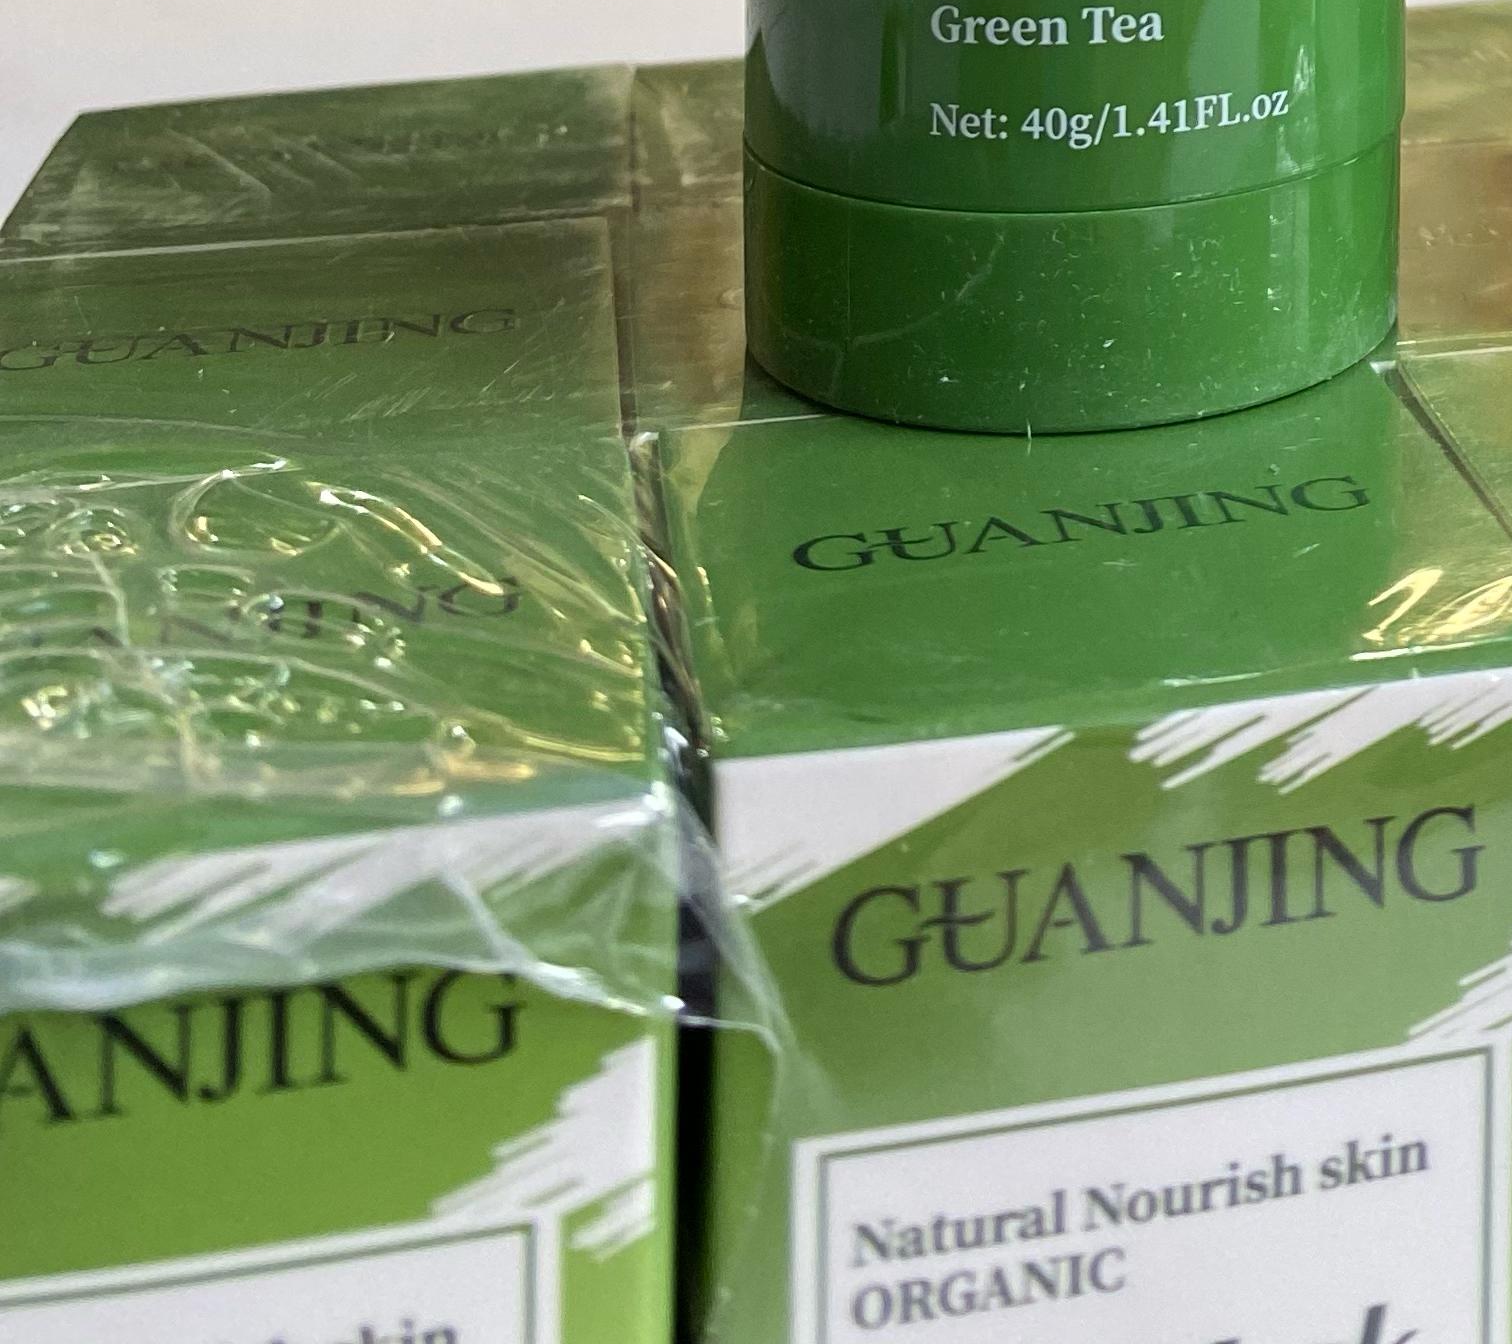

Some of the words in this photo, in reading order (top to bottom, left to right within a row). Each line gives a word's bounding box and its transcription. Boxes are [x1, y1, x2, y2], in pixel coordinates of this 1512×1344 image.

[932, 6, 1068, 45] Green
[1082, 7, 1164, 43] Tea
[930, 103, 1008, 139] Net:
[1021, 89, 1289, 150] 40g/1.41FL.oz
[793, 475, 1369, 572] GUANJING
[831, 805, 1486, 989] GUANJING
[850, 1191, 1067, 1270] Natural
[1083, 1152, 1303, 1228] Nourish
[1318, 1132, 1430, 1190] skin
[850, 1248, 1126, 1331] ORGANIC
